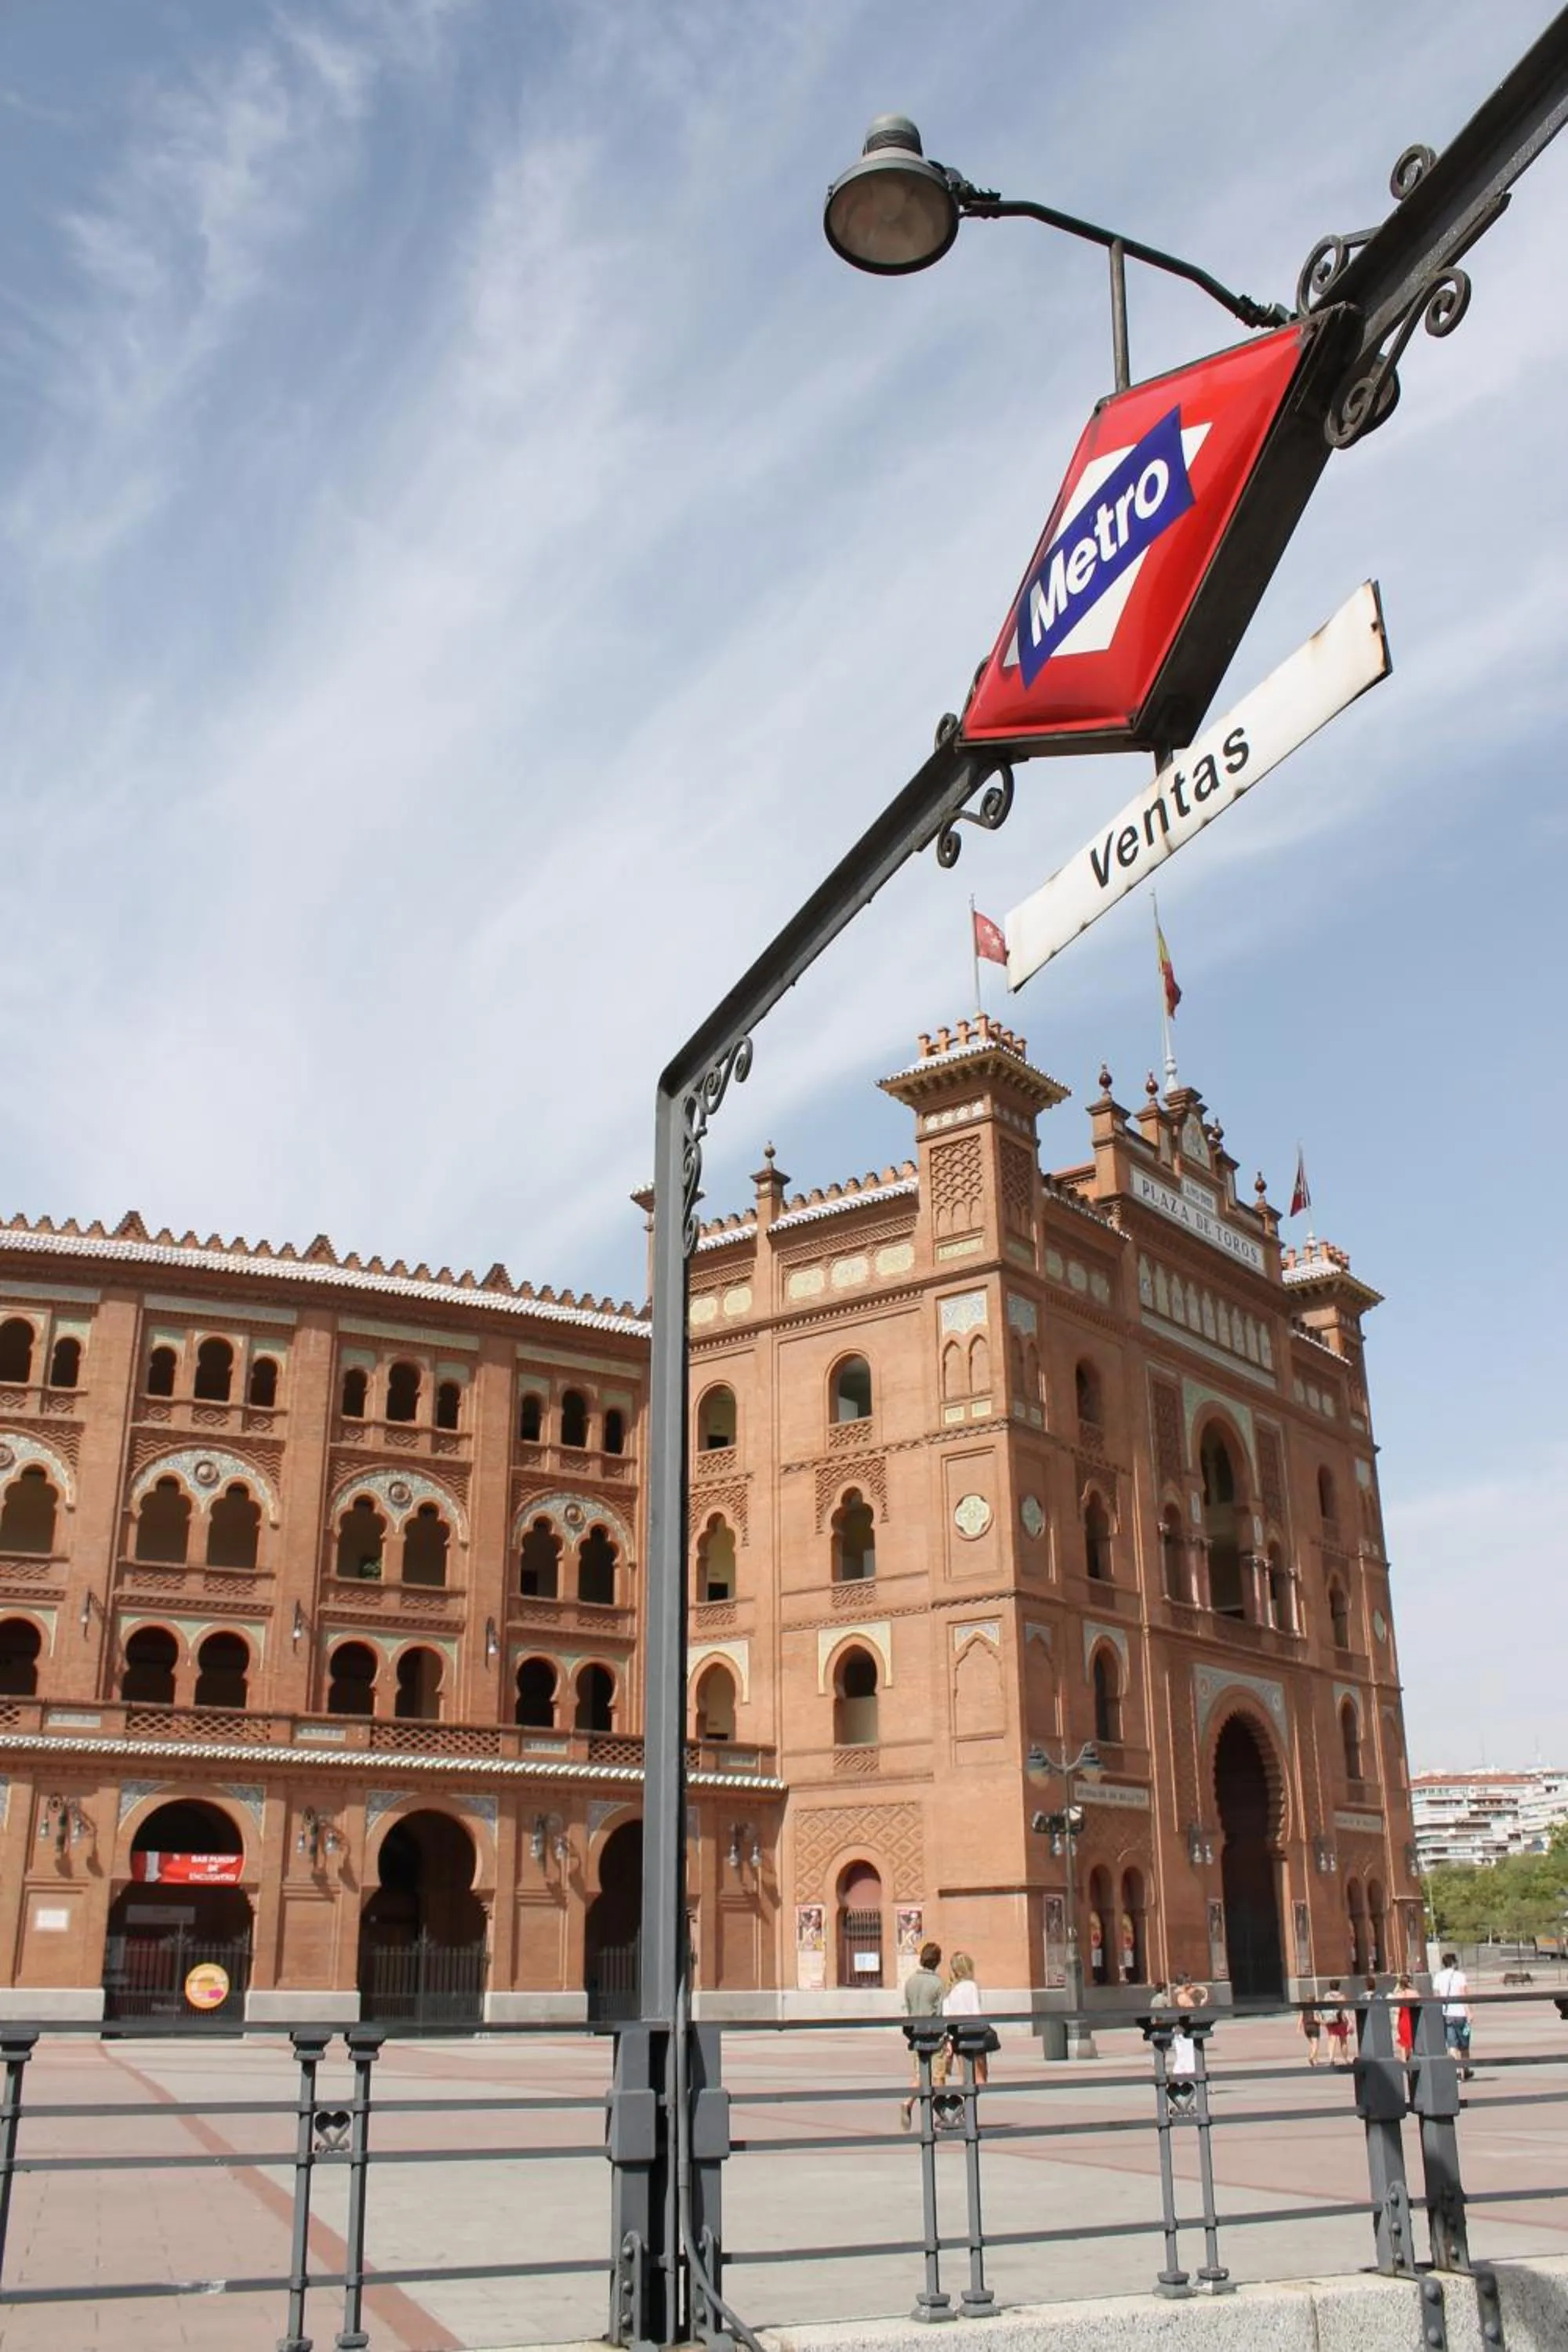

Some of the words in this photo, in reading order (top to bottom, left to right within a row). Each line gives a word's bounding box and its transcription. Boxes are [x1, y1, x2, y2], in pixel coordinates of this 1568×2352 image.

[1029, 459, 1169, 648] Metro
[1090, 727, 1250, 888] Ventas
[1142, 1179, 1189, 1224] PLAZA
[1196, 1214, 1211, 1236] DE
[1216, 1225, 1258, 1264] TOROS
